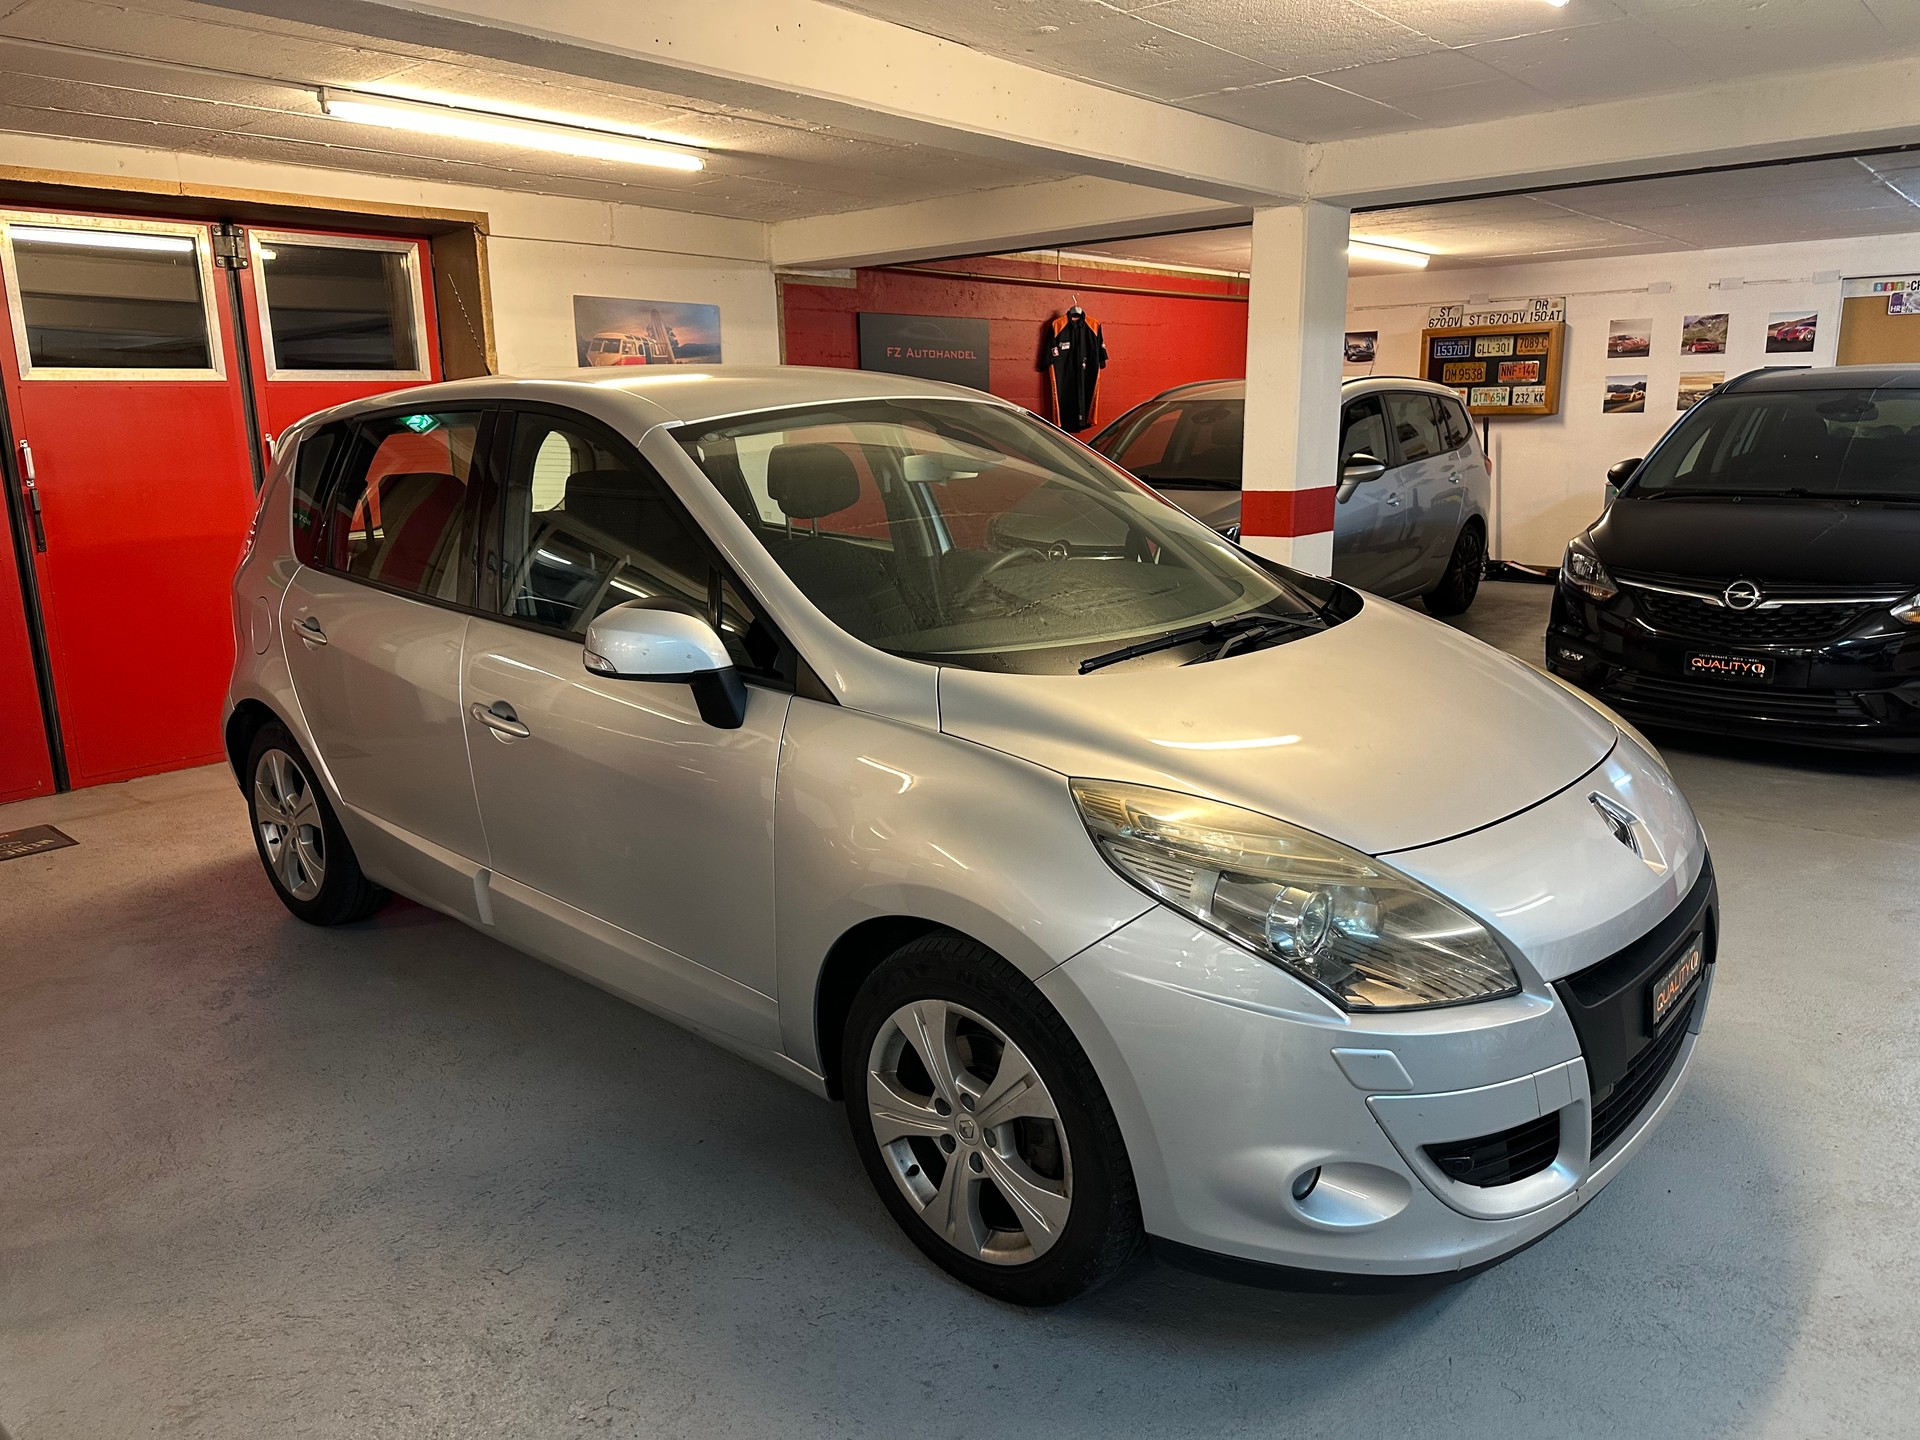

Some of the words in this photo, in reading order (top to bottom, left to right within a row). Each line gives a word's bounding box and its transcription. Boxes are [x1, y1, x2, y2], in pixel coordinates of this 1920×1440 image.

[1440, 307, 1454, 318] ST
[1468, 314, 1481, 326] ST
[886, 347, 901, 358] FZ
[1515, 393, 1530, 403] 232
[1533, 392, 1545, 403] KK
[1691, 657, 1751, 672] QUALITY
[1656, 960, 1691, 1012] QUALITY
